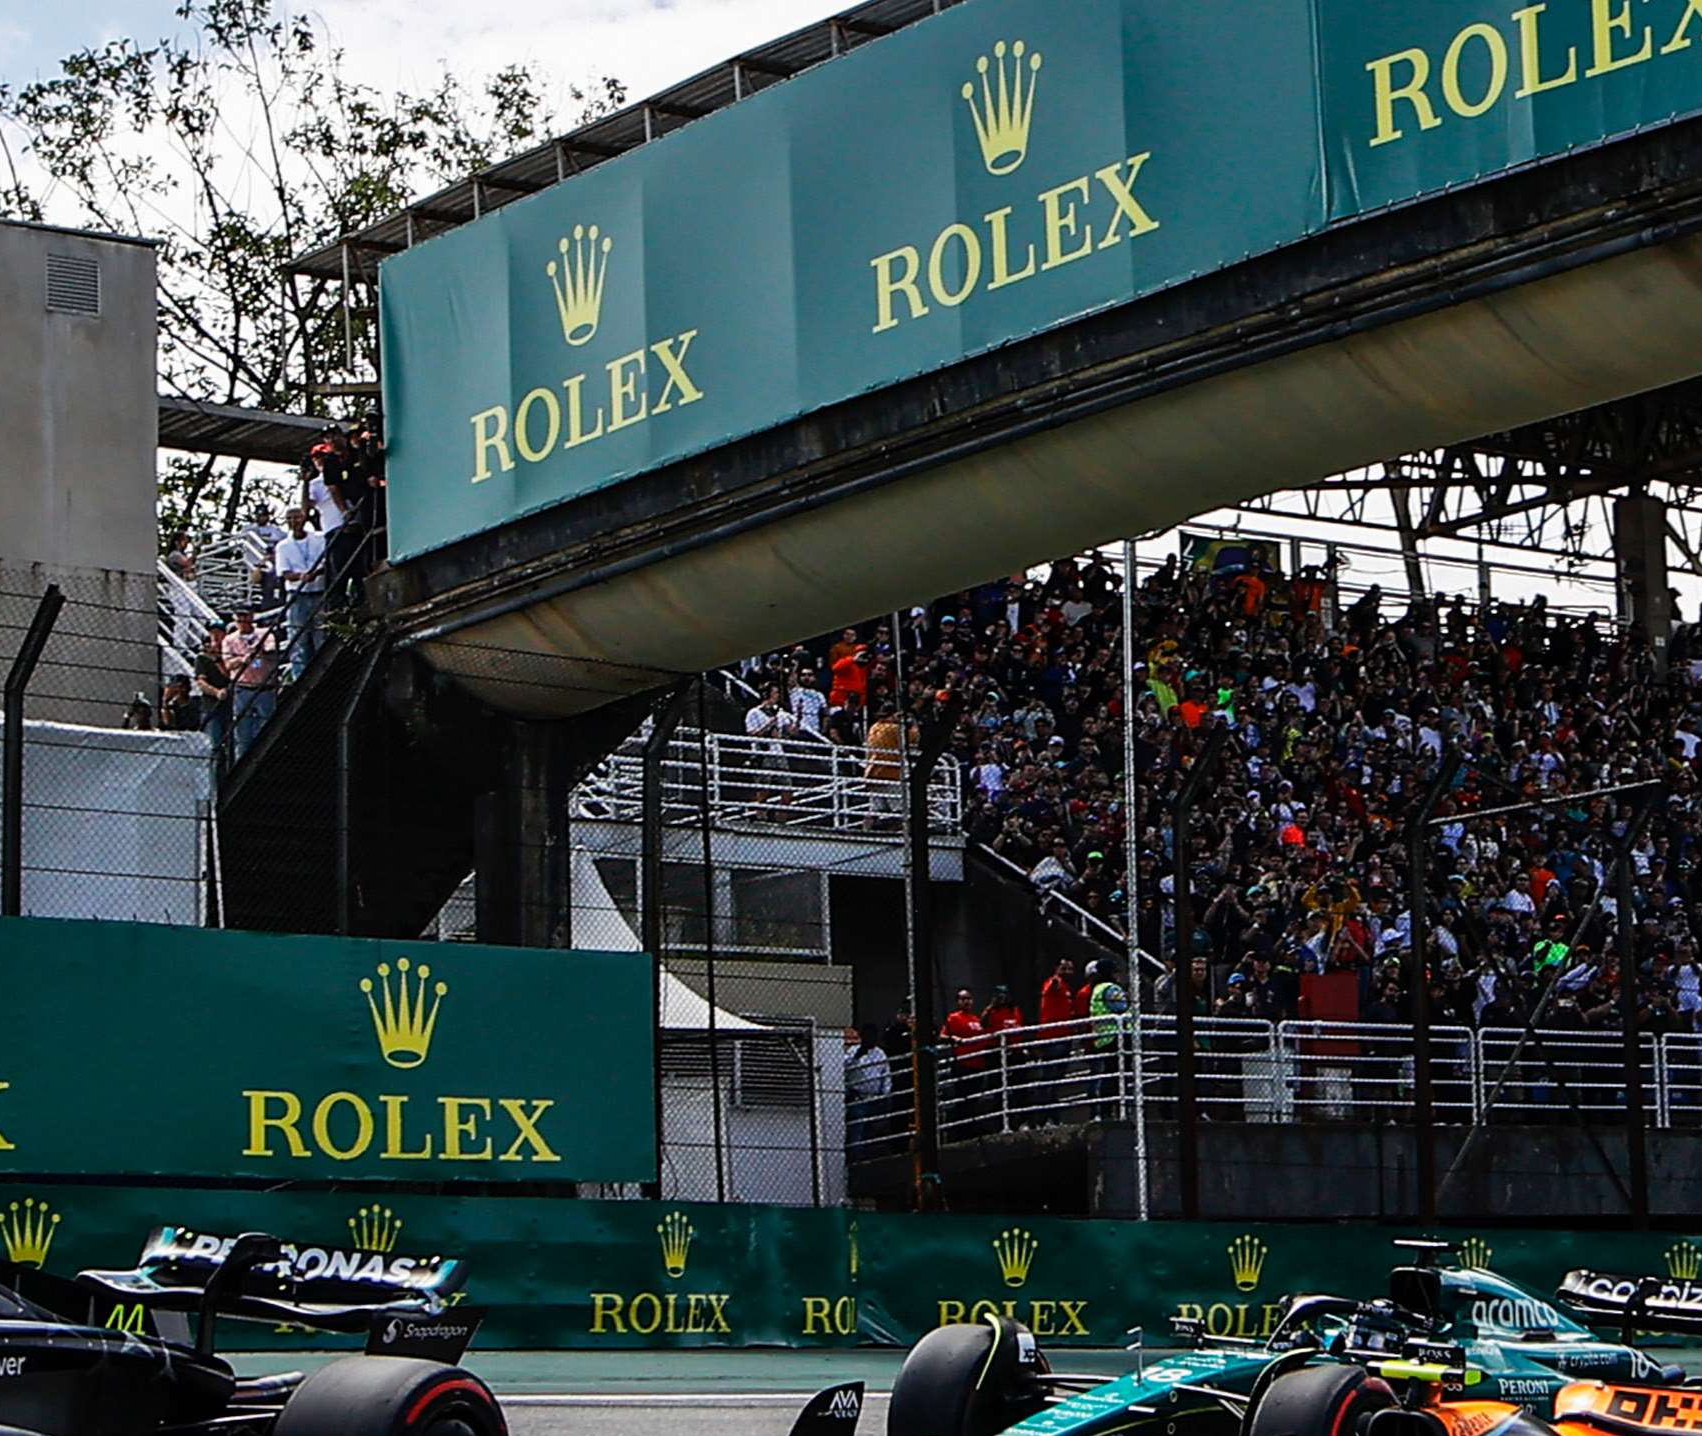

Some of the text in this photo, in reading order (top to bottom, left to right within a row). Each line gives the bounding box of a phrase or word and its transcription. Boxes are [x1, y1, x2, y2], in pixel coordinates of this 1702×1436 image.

[870, 152, 1159, 334] ROLEX
[469, 329, 703, 484] ROLEX
[242, 1090, 561, 1162] ROLEX
[185, 1235, 417, 1283] PERONAS
[403, 1322, 468, 1340] Snapdragon
[589, 1293, 731, 1334] ROLEX
[1177, 1302, 1313, 1337] ROLE
[1472, 1298, 1560, 1329] aramco
[1498, 1377, 1550, 1395] PERONI
